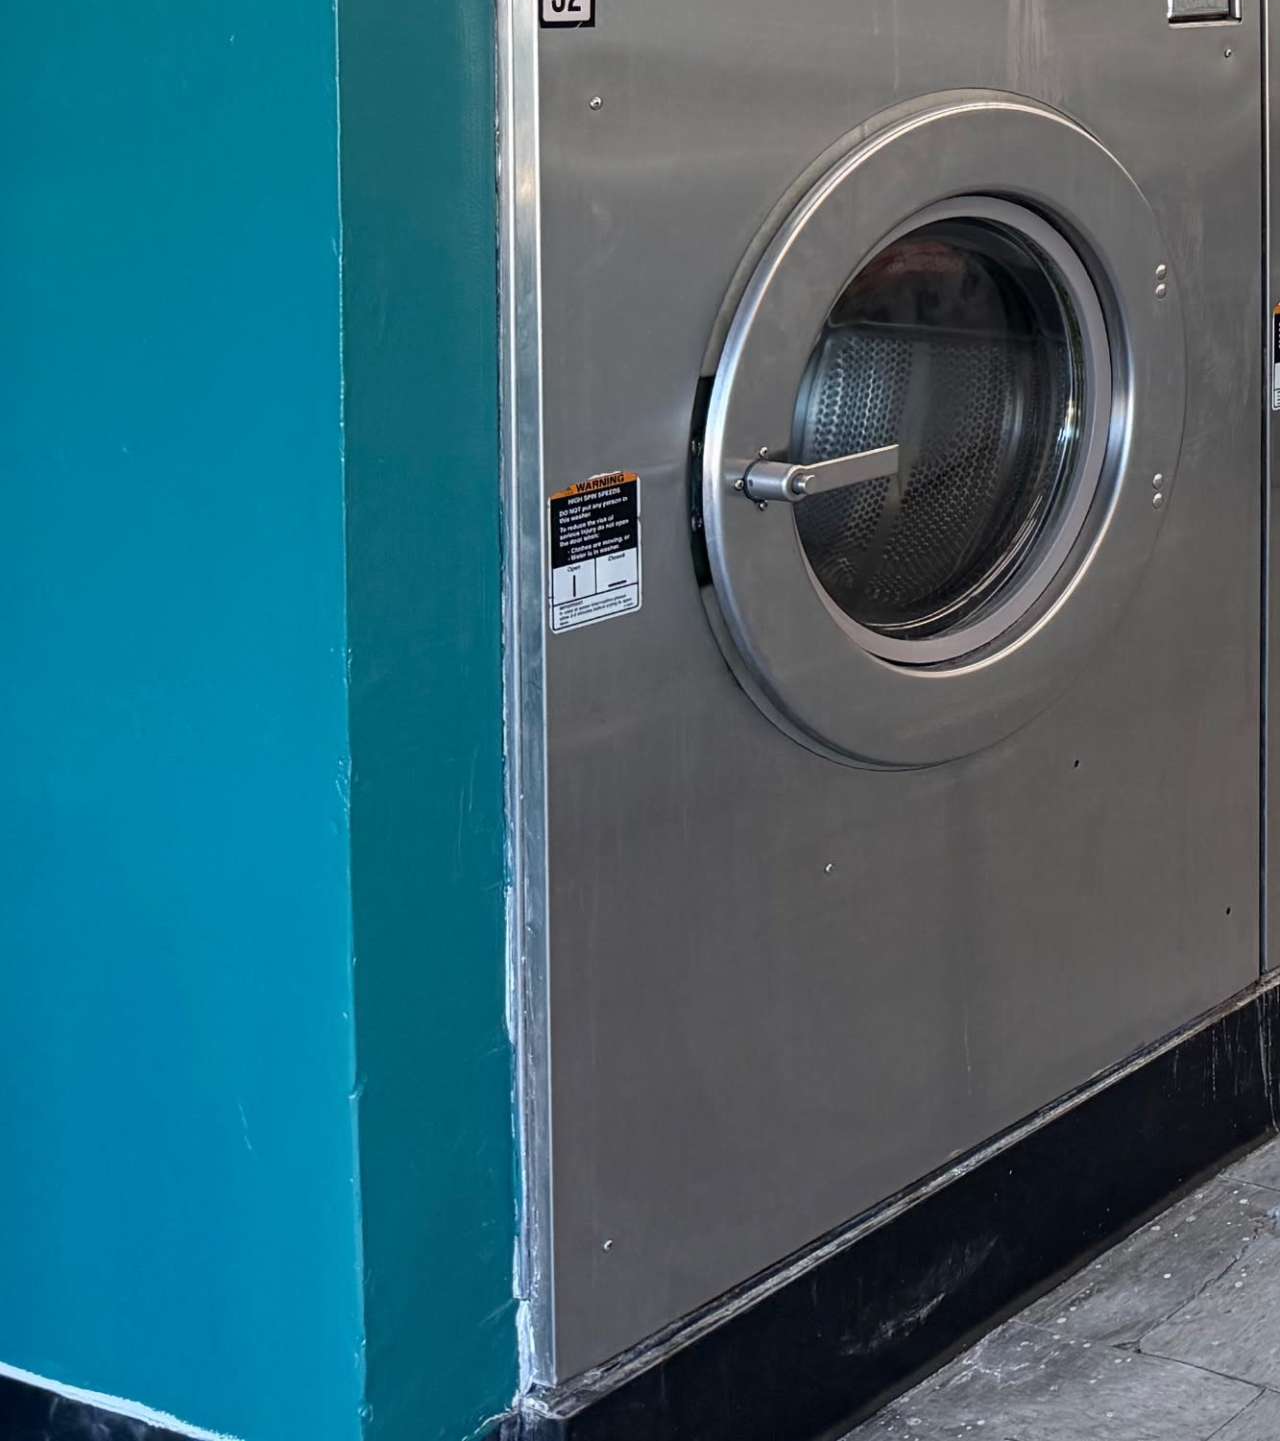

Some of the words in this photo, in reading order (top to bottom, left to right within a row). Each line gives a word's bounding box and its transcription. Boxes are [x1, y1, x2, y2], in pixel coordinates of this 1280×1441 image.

[575, 474, 624, 491] WARNING
[559, 509, 569, 518] DO
[569, 506, 582, 515] NOT
[602, 497, 622, 508] person
[567, 496, 583, 505] HIGH
[583, 493, 597, 502] SPIN
